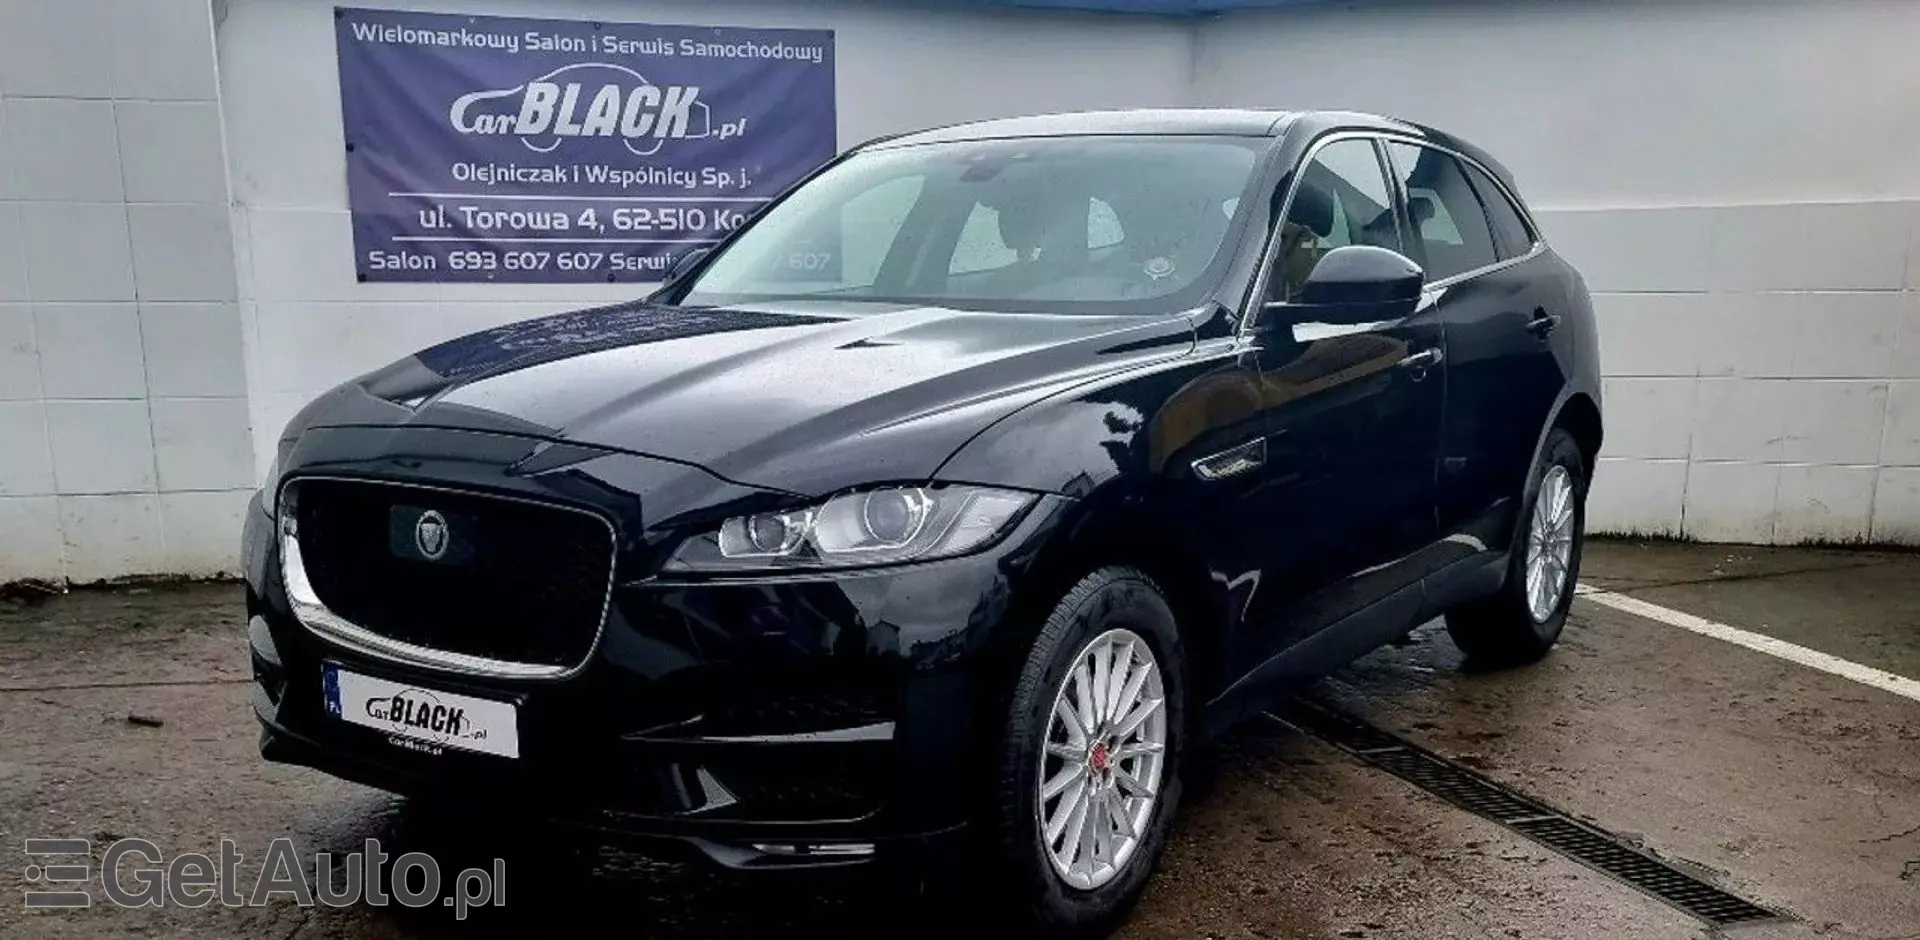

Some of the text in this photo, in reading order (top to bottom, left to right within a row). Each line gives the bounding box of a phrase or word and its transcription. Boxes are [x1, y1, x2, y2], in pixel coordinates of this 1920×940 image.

[351, 22, 823, 63] Wielomarkowy Salon i Serwis Samochodowy
[452, 163, 567, 185] Olejniczak
[584, 165, 697, 188] Wspólnicy
[702, 168, 735, 189] Sp.
[739, 168, 752, 189] j.
[419, 204, 752, 233] ul. Torowa 4, 62-510 Ko
[369, 251, 436, 270] Salon
[449, 251, 497, 270] 693
[503, 252, 551, 270] 607
[557, 252, 604, 270] 607
